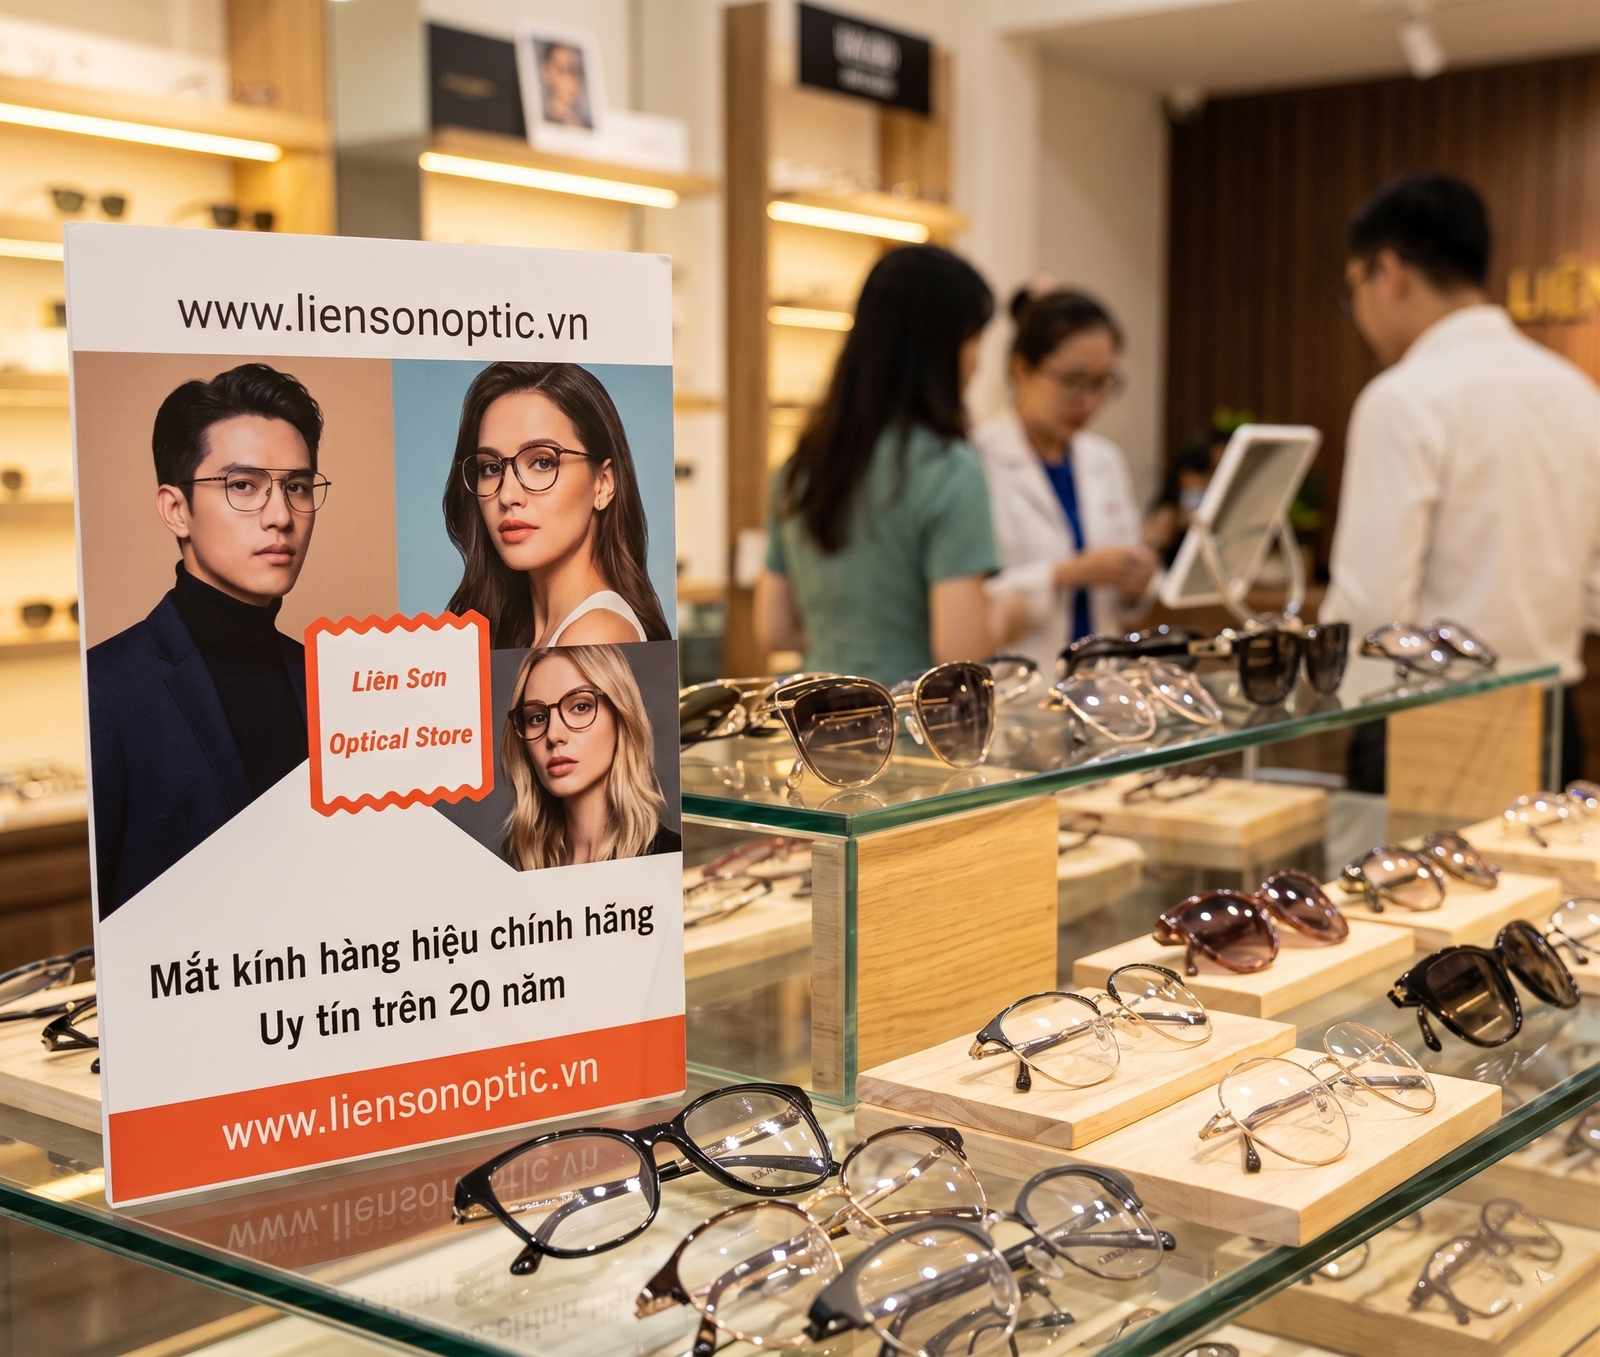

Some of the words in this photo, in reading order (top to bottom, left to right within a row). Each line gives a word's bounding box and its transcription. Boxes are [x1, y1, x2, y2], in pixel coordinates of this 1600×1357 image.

[177, 292, 588, 347] www.liensonoptic.vn
[351, 669, 399, 693] Liên
[406, 667, 447, 689] Sơn
[329, 726, 410, 759] Optical
[415, 725, 473, 749] Store
[150, 950, 220, 1000] Mắt
[232, 946, 306, 988] kính
[320, 938, 401, 975] hàng
[412, 924, 478, 965] hiệu
[490, 909, 573, 951] chính
[585, 902, 654, 937] hãng
[260, 1009, 305, 1051] Uy
[315, 1000, 360, 1037] tín
[372, 990, 437, 1028] trên
[449, 979, 491, 1017] 20
[502, 972, 565, 1008] năm
[221, 1058, 598, 1151] www.liensonoptic.vn
